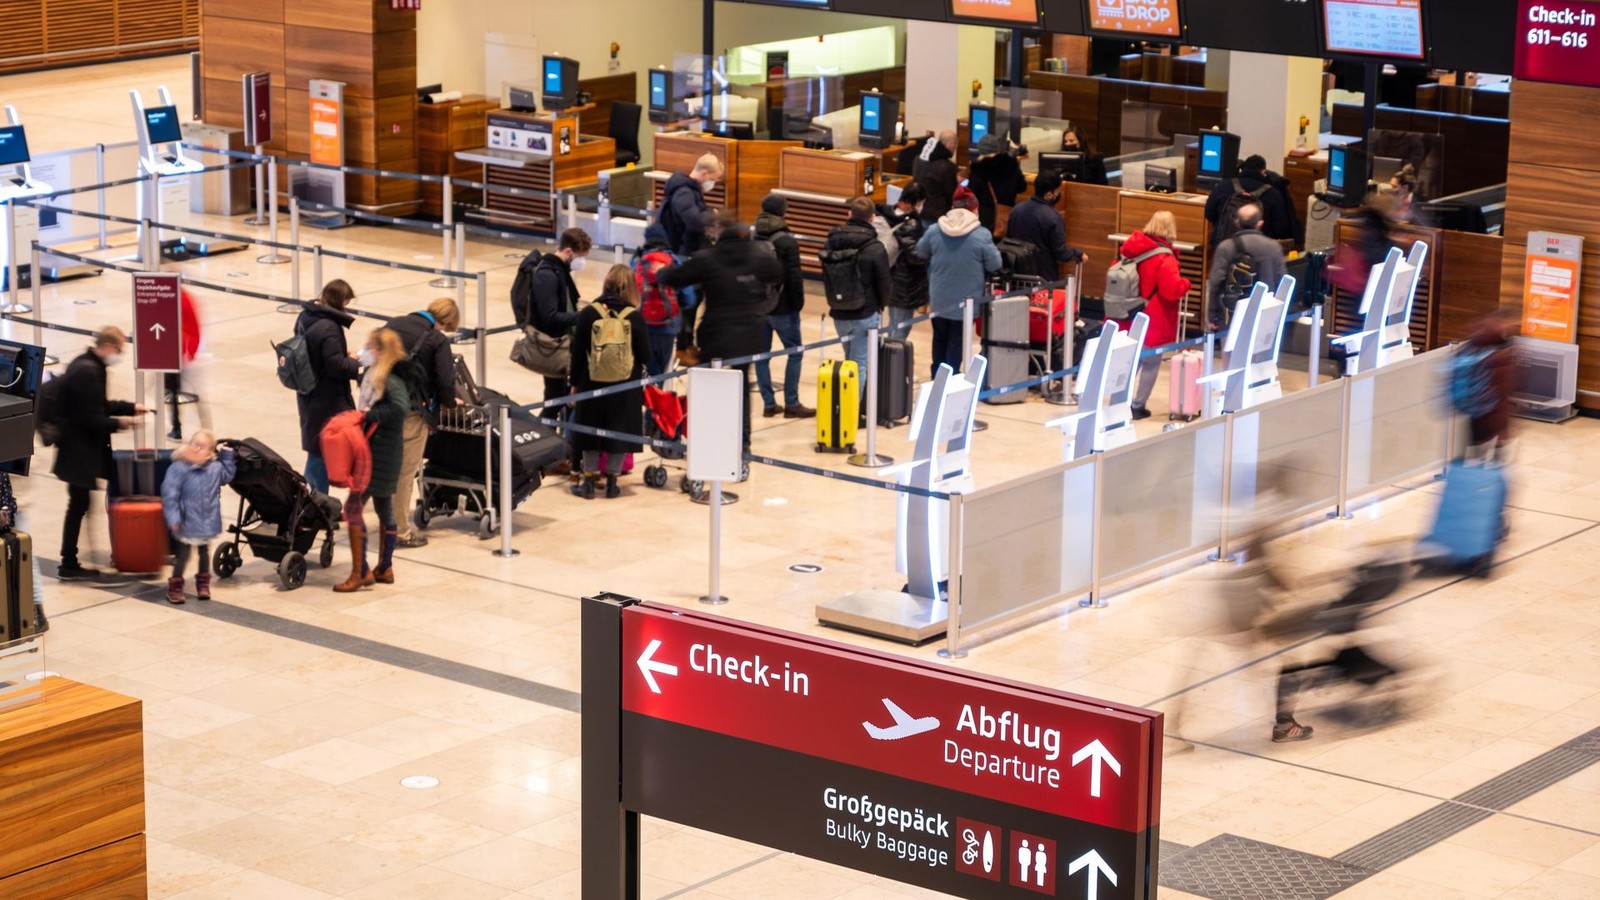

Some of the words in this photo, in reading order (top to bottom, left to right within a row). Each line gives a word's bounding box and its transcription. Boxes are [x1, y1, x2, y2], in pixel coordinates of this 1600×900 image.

[1125, 4, 1170, 22] DROP
[1529, 5, 1596, 26] Check-in
[689, 643, 809, 696] Check-in
[956, 704, 1061, 761] Abflug
[944, 739, 1060, 788] Departure
[823, 787, 949, 838] Großgepäck
[826, 818, 871, 849] Bulky
[877, 831, 948, 867] Baggage
